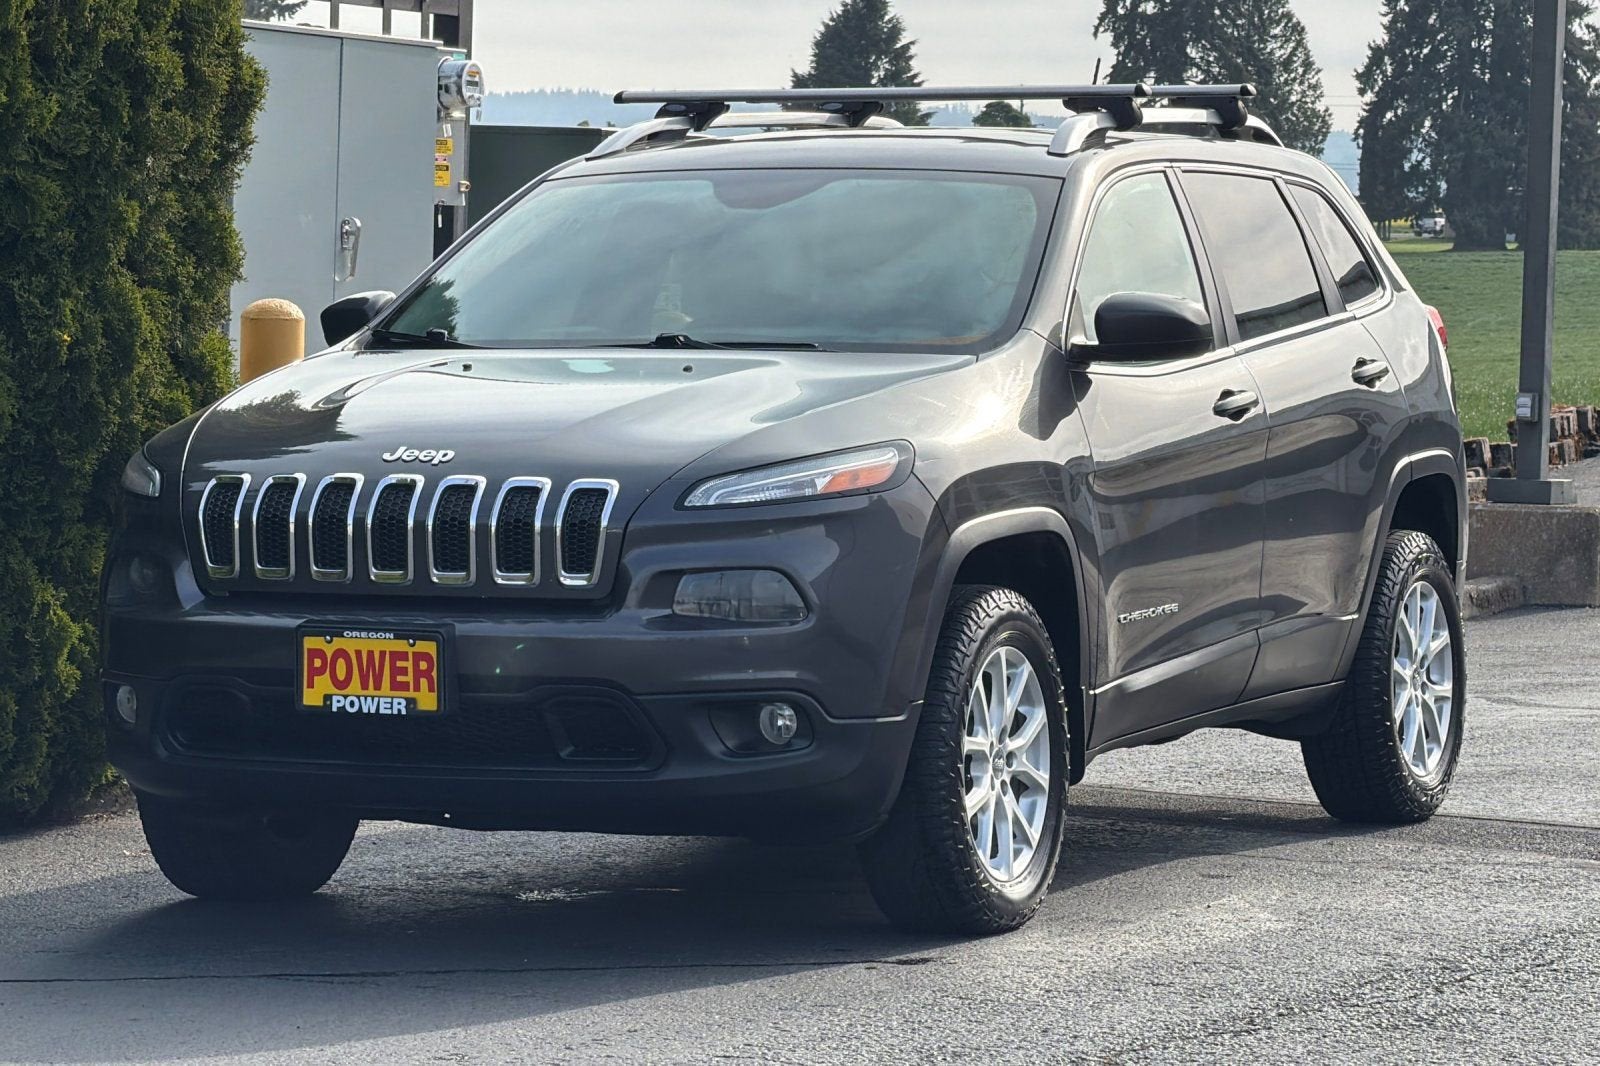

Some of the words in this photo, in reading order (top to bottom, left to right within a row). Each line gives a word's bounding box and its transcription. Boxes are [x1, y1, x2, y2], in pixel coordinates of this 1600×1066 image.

[382, 446, 455, 466] Jeep
[1118, 603, 1179, 623] CHEROKEE
[343, 631, 394, 639] OREGON
[306, 648, 436, 693] POWER
[331, 695, 407, 715] POWER
